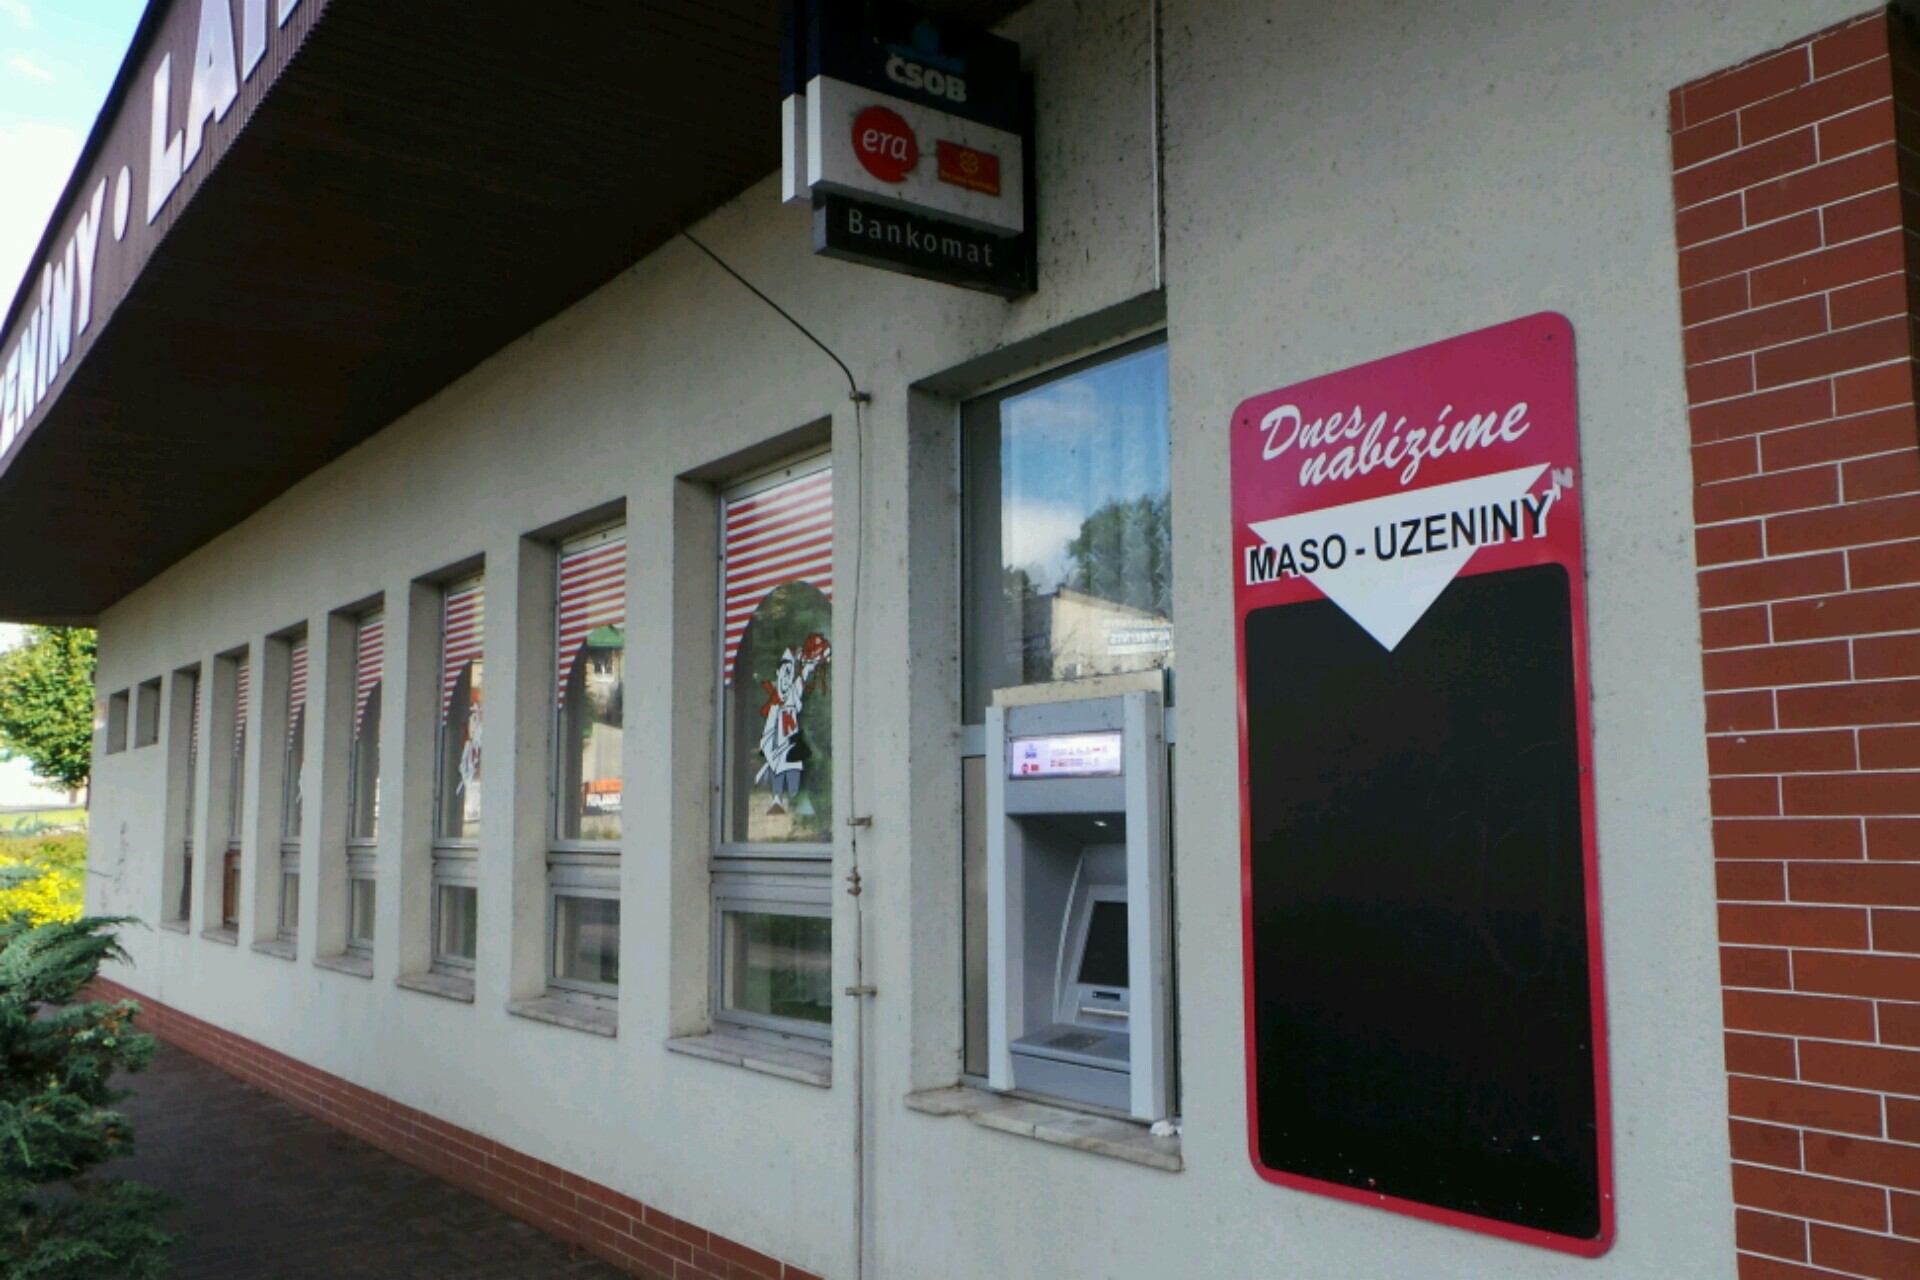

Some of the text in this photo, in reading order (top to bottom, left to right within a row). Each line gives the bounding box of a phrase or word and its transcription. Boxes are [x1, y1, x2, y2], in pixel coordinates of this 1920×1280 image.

[886, 54, 967, 103] ČSOB
[862, 129, 908, 162] era
[849, 209, 993, 266] Bankomat
[1260, 404, 1367, 460] Dnes
[1299, 402, 1530, 485] nabízíme
[1246, 535, 1347, 584] MASO
[1375, 493, 1552, 560] UZENINY
